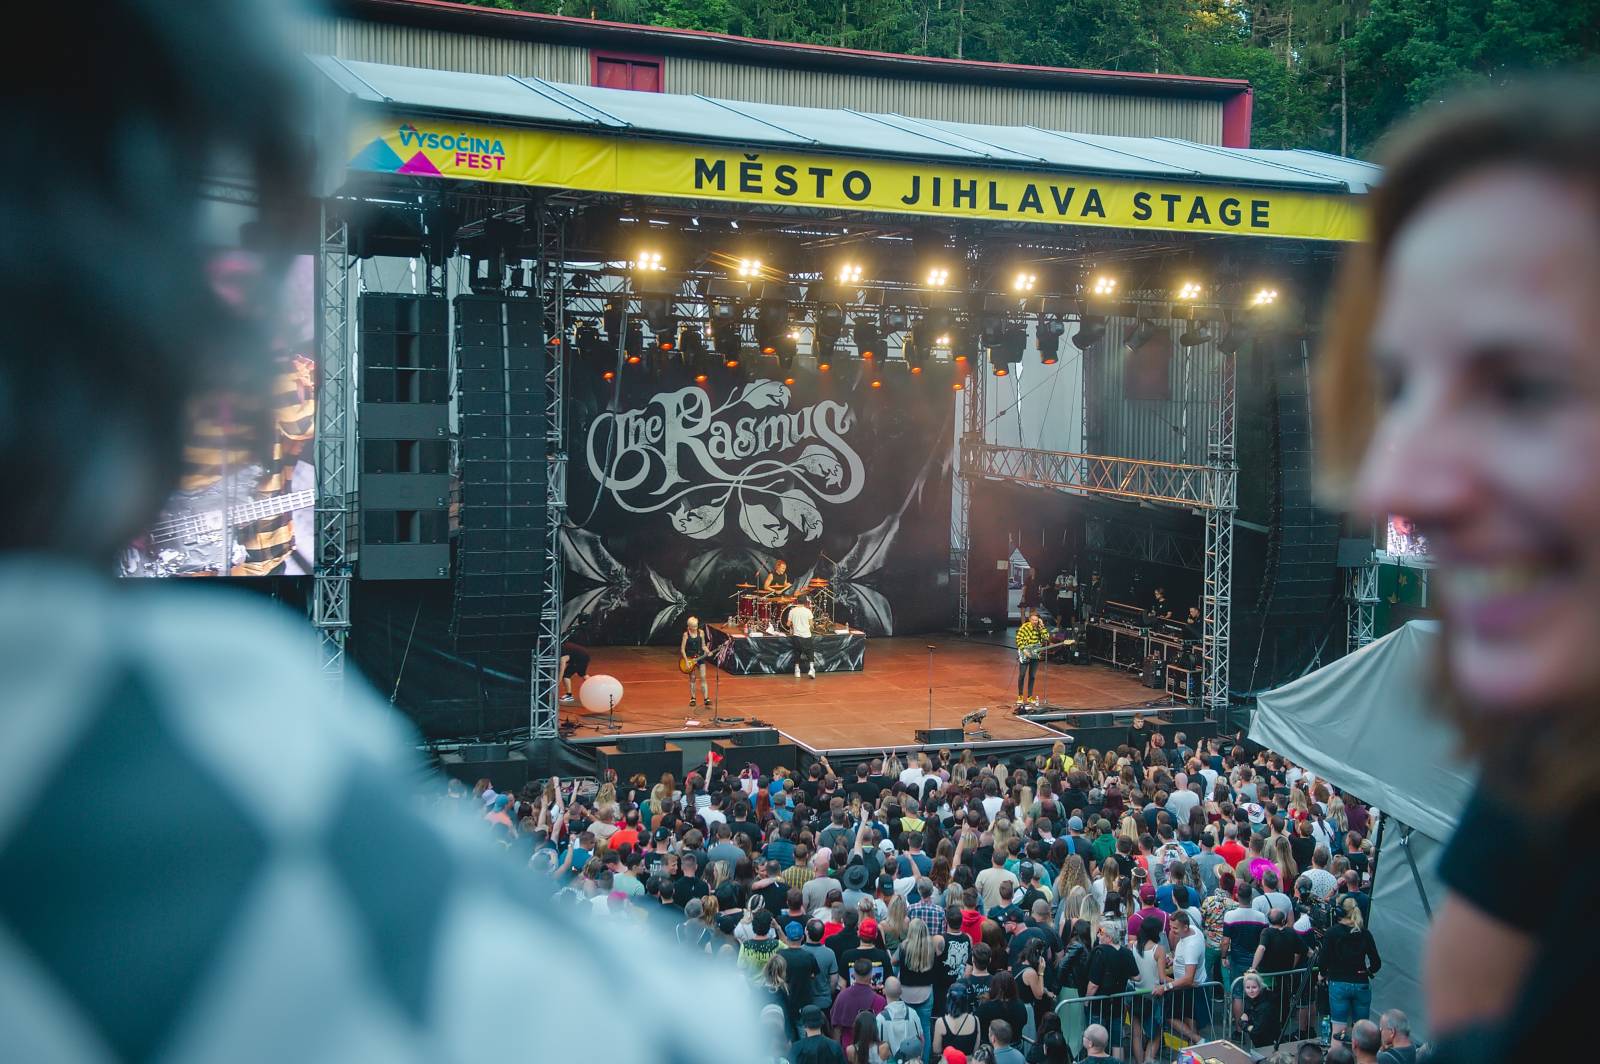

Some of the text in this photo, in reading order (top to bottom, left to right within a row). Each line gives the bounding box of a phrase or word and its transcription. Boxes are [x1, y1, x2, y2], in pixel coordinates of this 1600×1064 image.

[400, 130, 505, 155] VYSOČINA
[455, 152, 505, 171] FEST
[694, 153, 1270, 228] MĚSTO JIHLAVA STAGE
